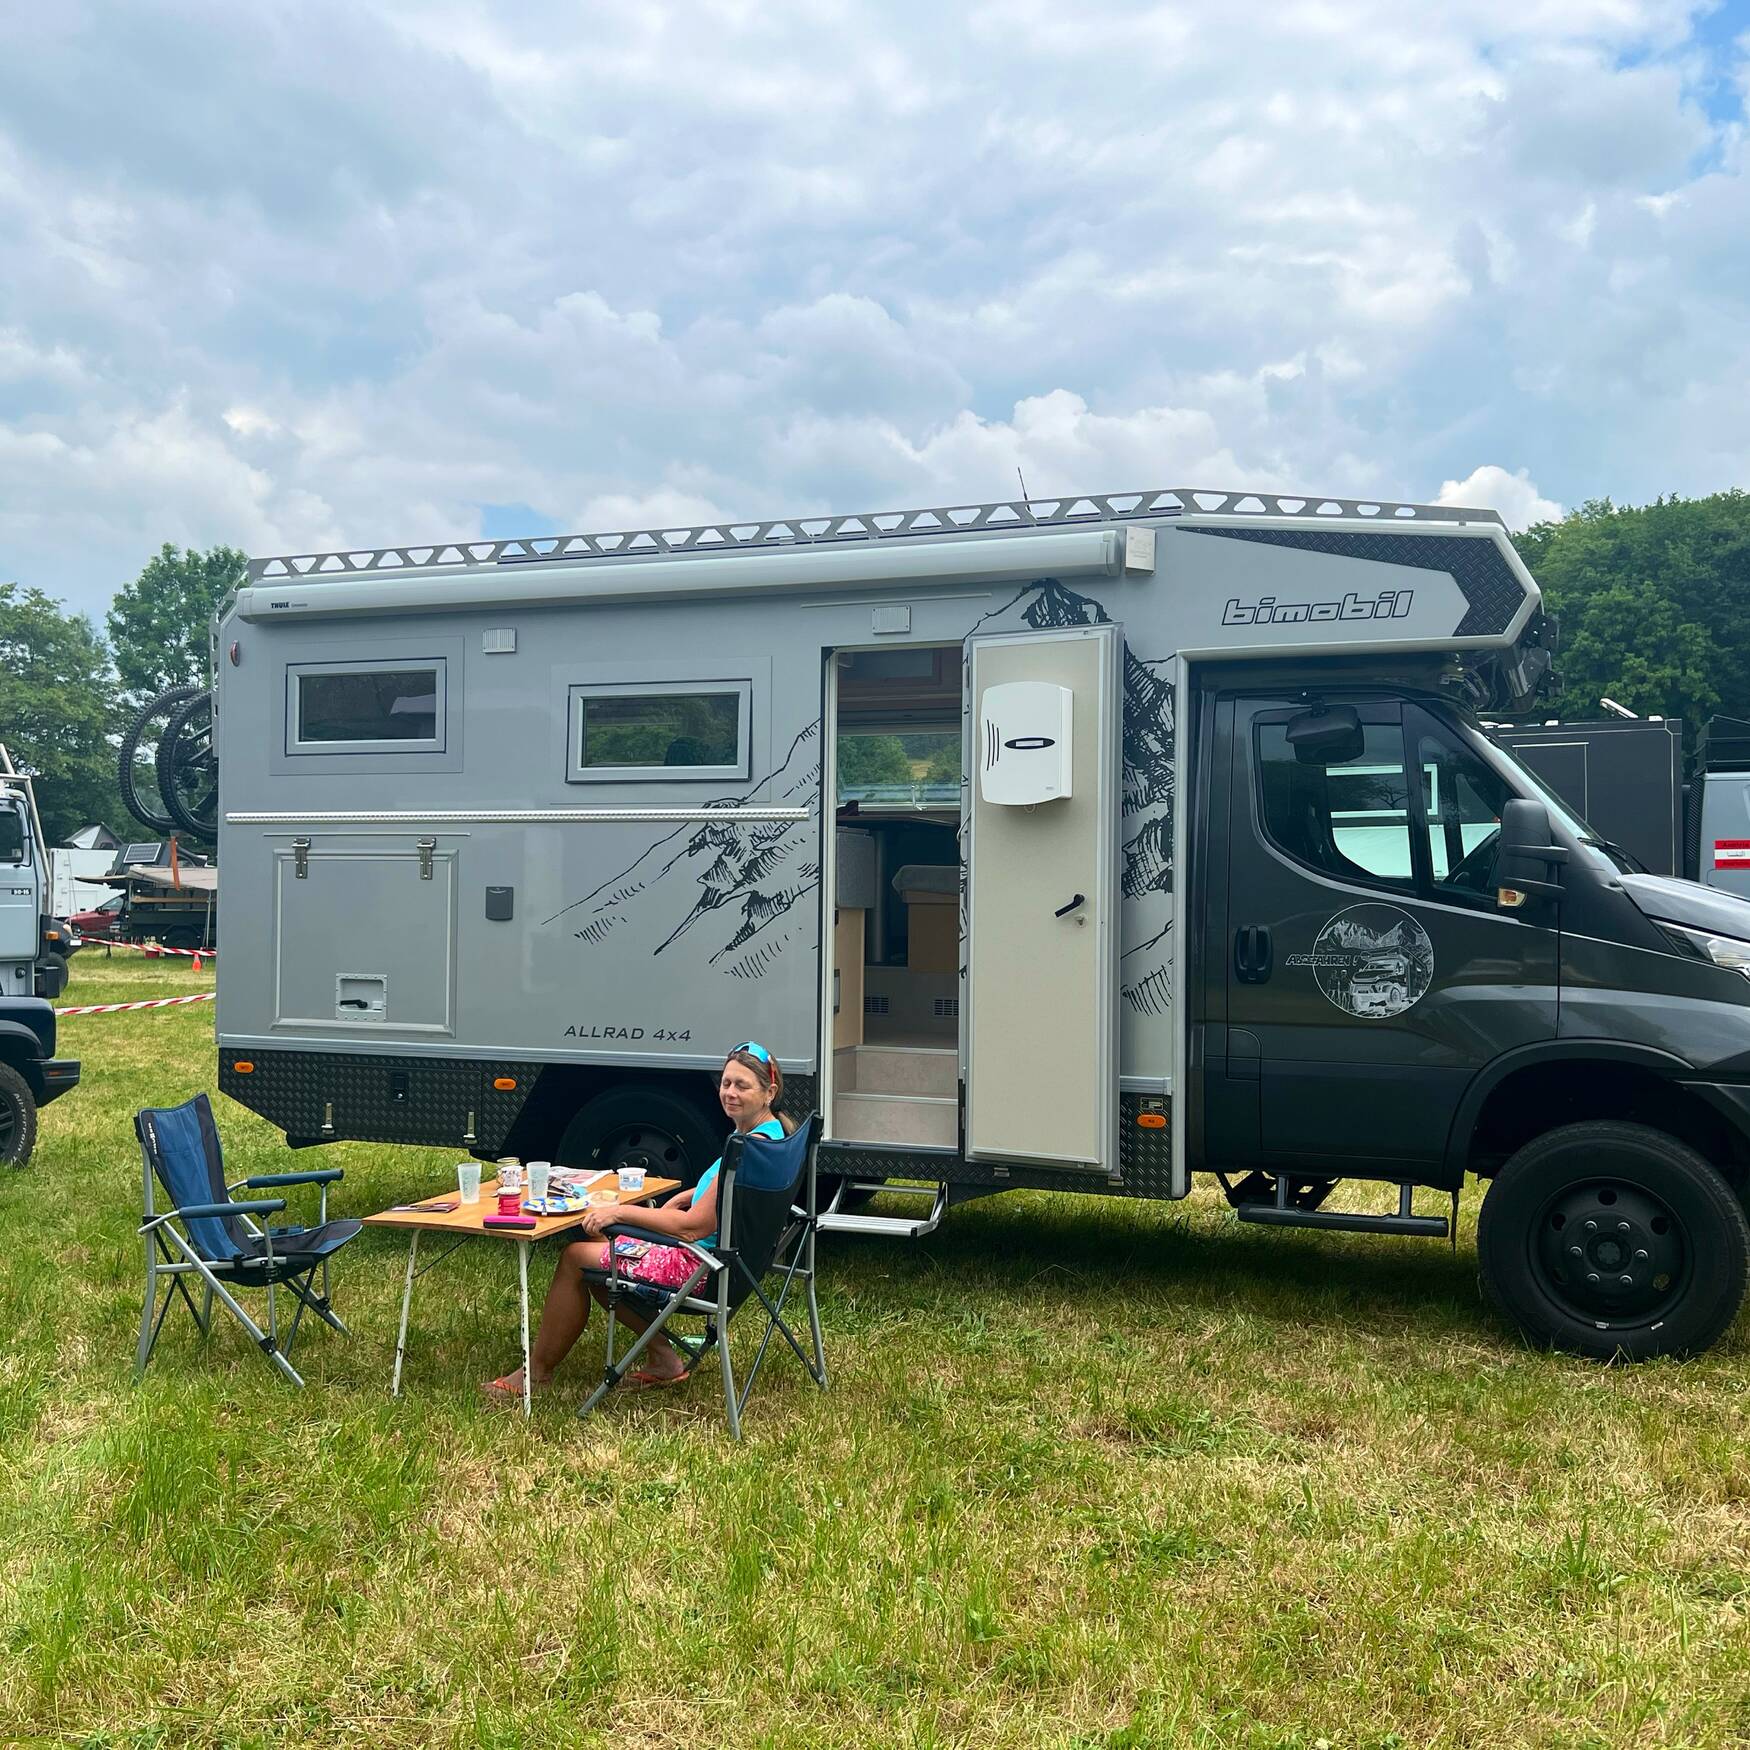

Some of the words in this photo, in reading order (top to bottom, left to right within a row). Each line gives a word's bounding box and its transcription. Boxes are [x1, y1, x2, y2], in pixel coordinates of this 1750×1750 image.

[1221, 590, 1414, 626] bimobil
[564, 1025, 645, 1040] ALLRAD
[653, 1029, 692, 1041] 4x4
